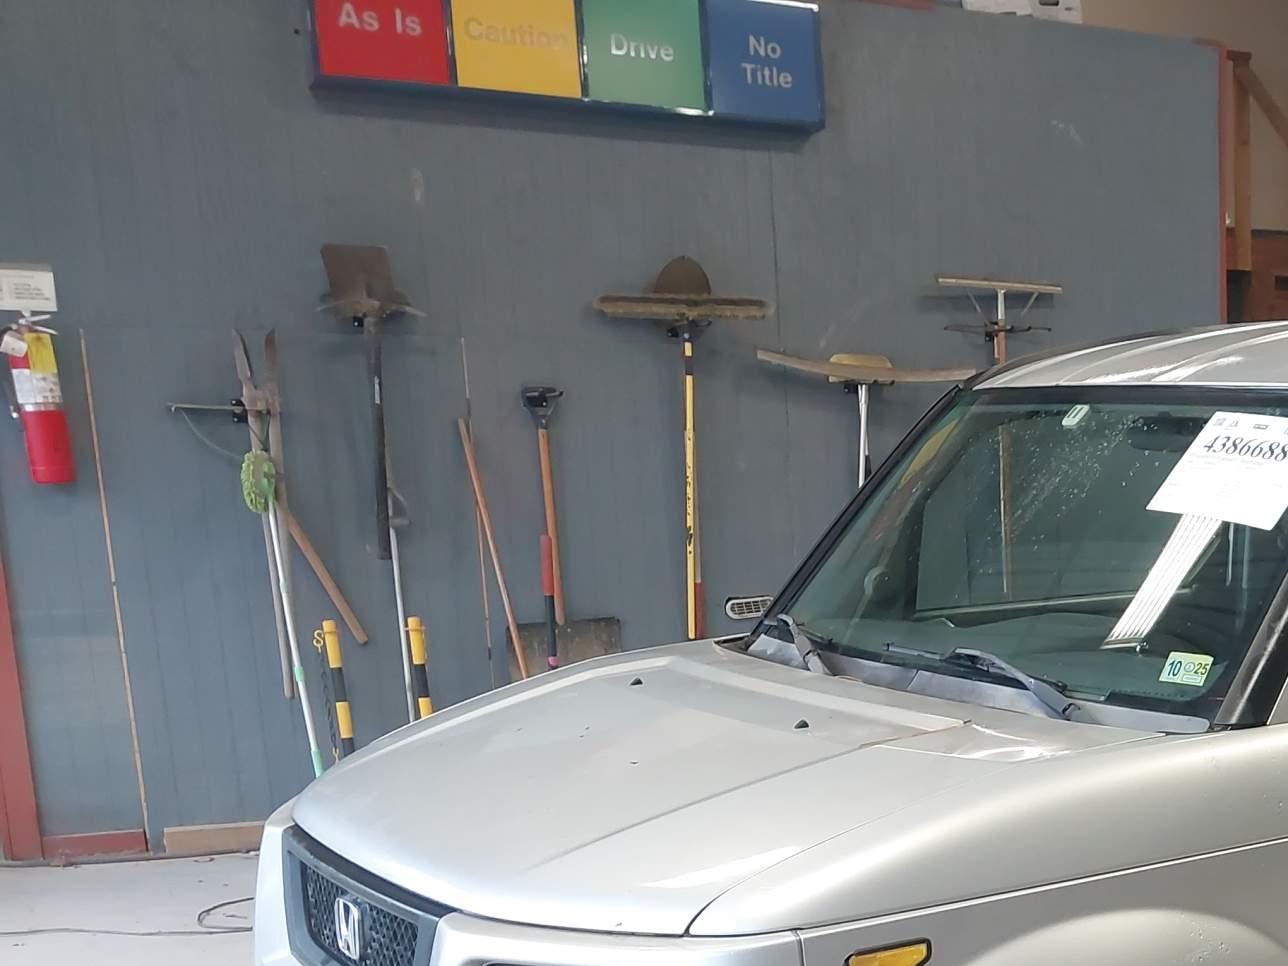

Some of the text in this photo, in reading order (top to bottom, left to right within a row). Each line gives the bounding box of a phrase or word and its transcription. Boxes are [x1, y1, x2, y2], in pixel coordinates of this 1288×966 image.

[338, 2, 422, 36] As Is
[463, 16, 570, 47] Caution
[610, 33, 674, 62] Drive
[749, 34, 782, 58] No
[741, 63, 793, 88] Title
[1167, 660, 1209, 677] 10 25
